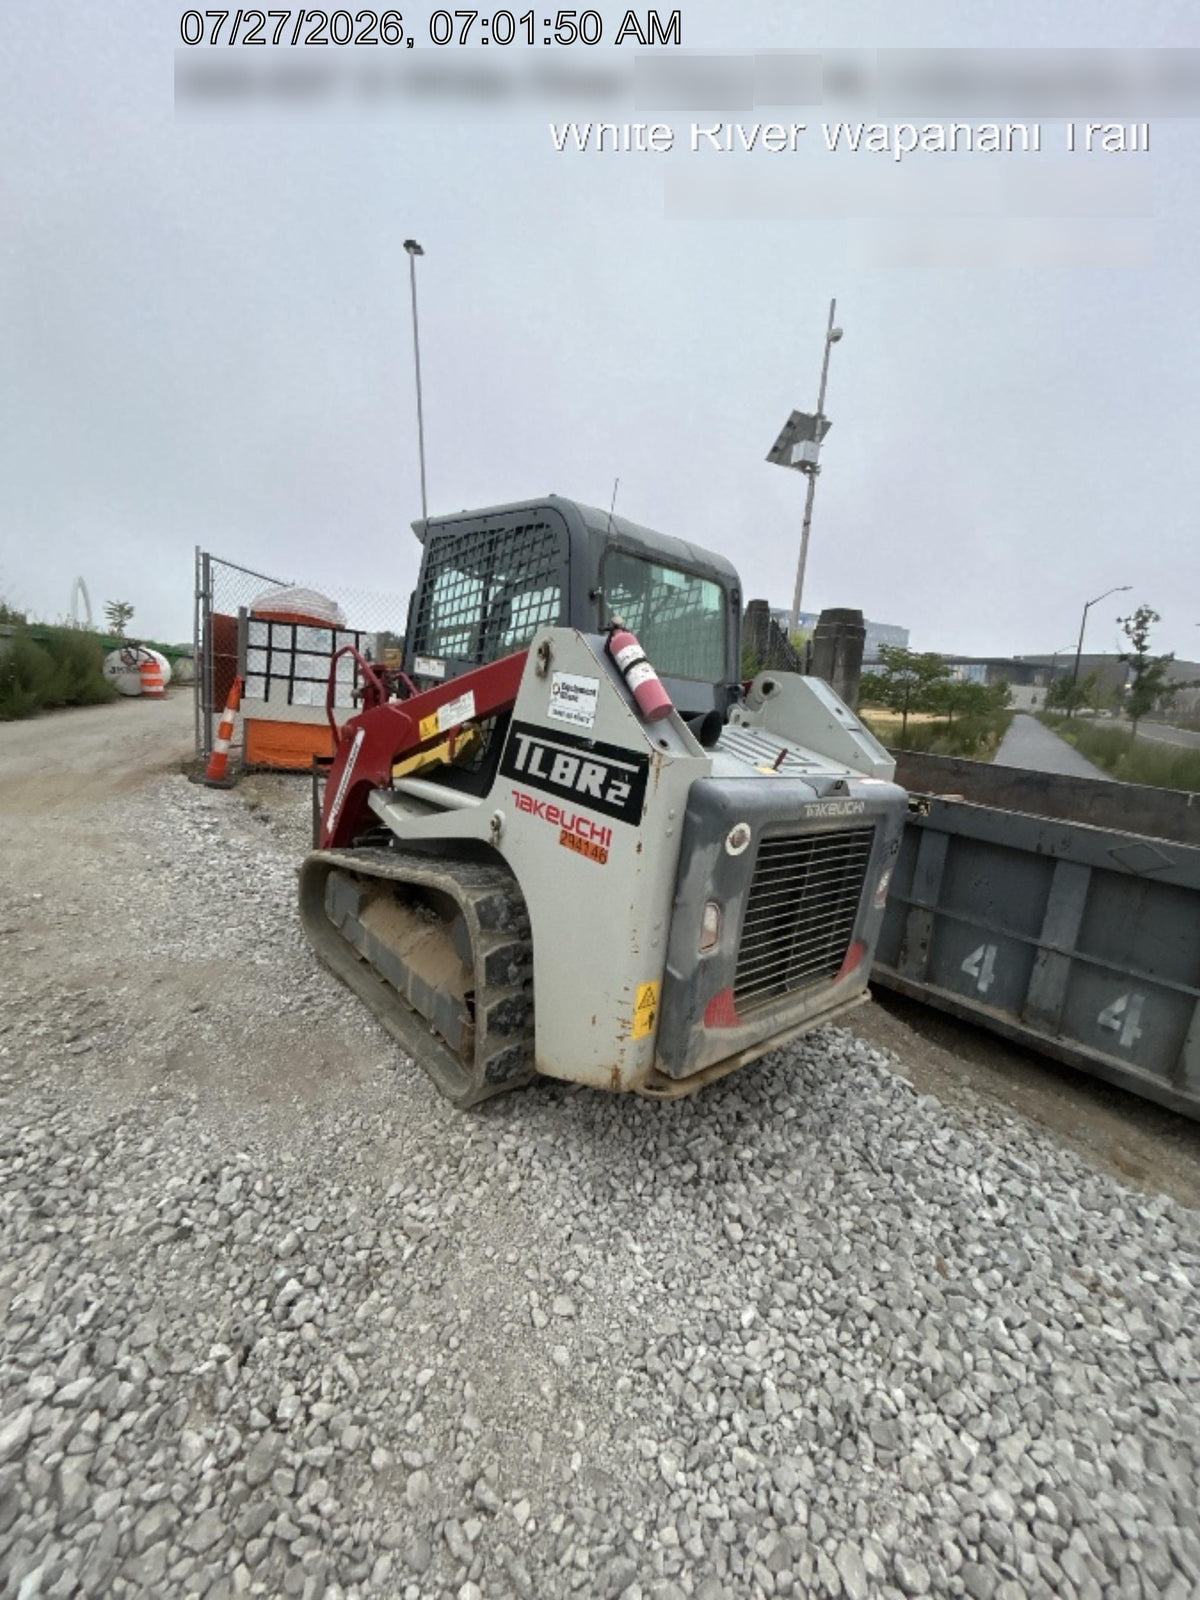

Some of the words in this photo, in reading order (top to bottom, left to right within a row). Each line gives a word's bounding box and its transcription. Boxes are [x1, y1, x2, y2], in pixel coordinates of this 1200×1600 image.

[804, 800, 865, 817] TAKEUCHI
[961, 943, 998, 993] 4
[1097, 993, 1146, 1049] 4
